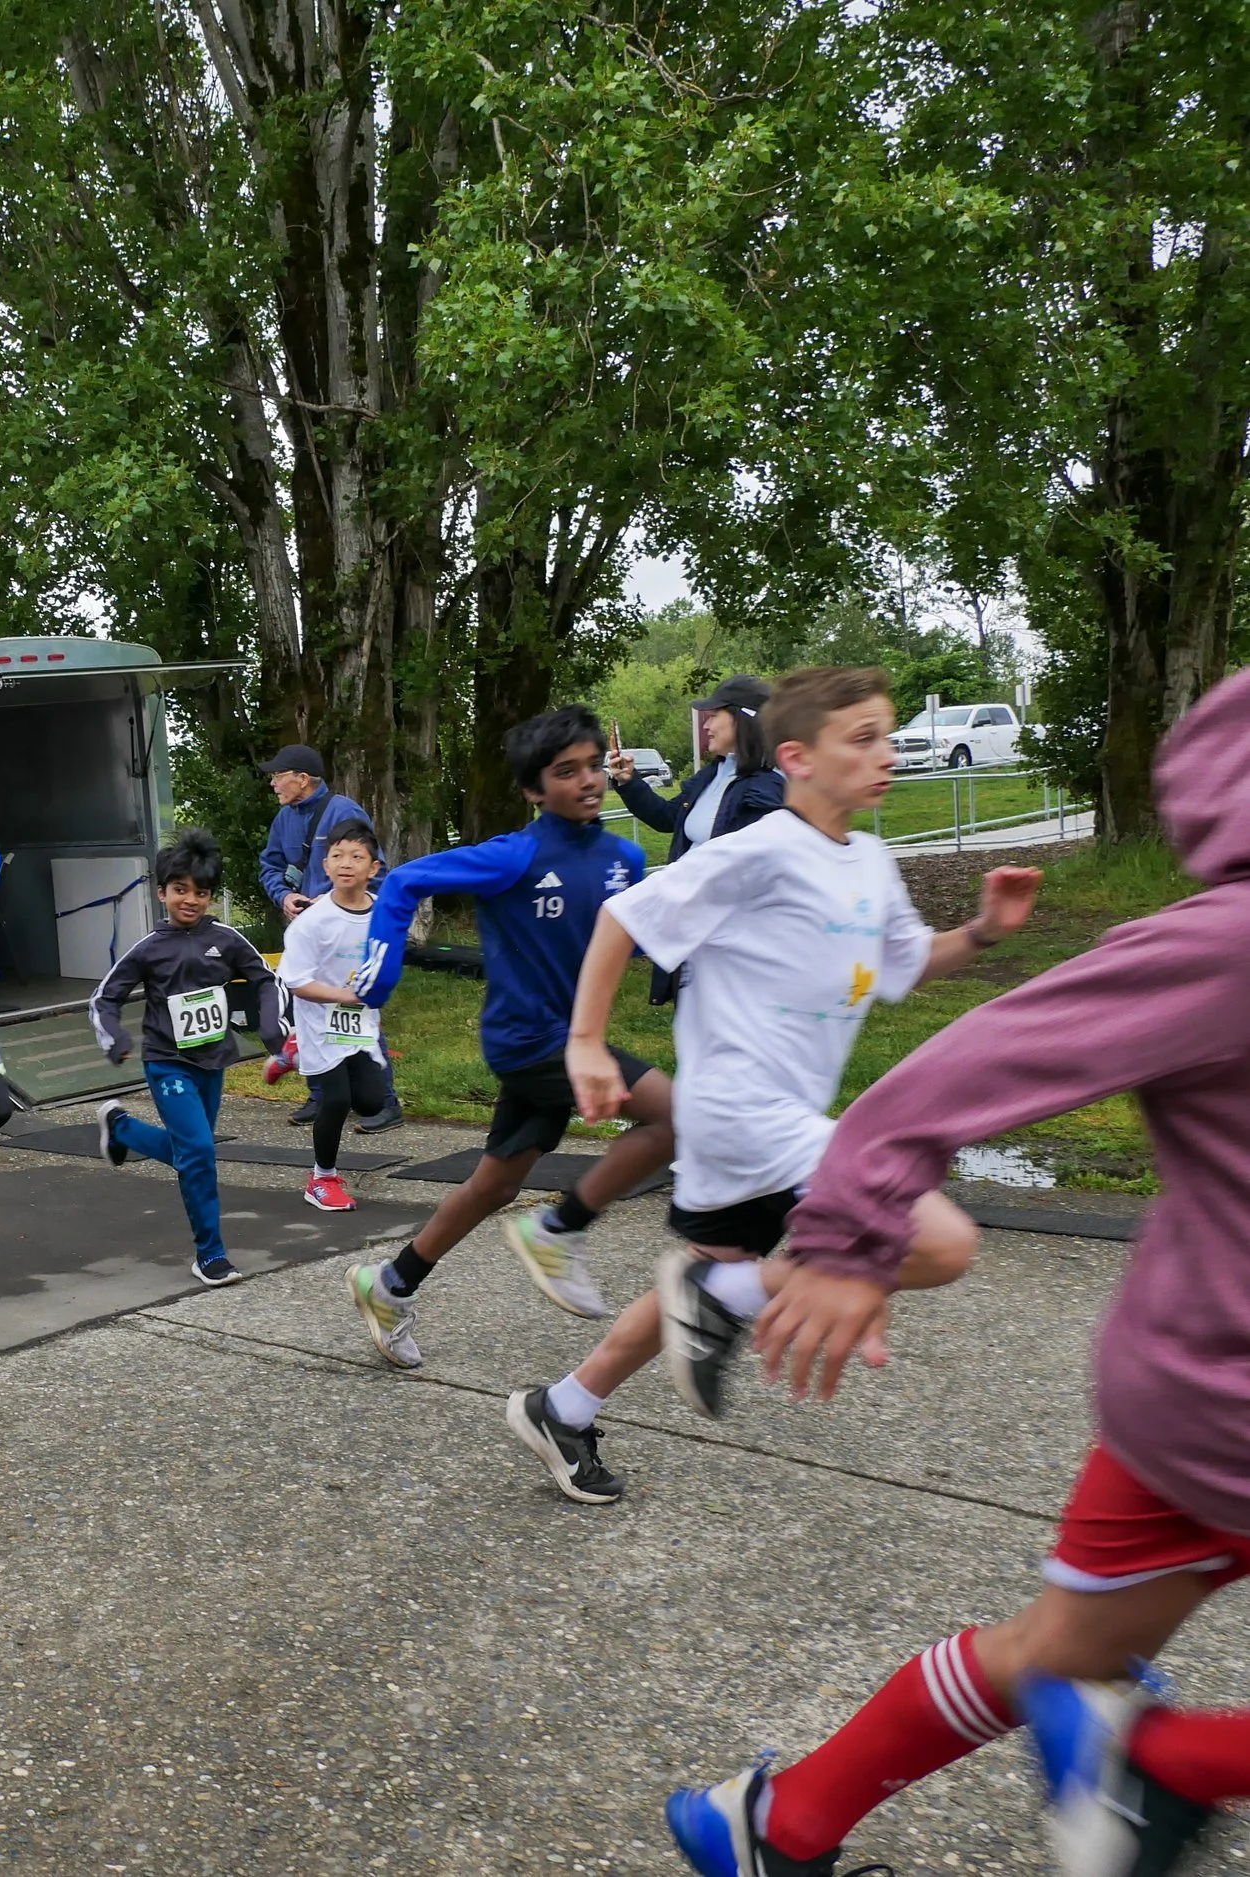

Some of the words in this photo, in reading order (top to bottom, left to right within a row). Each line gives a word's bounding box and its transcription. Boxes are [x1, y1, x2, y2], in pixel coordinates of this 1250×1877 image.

[531, 896, 564, 918] 19
[180, 1003, 223, 1037] 299
[330, 1010, 361, 1035] 403
